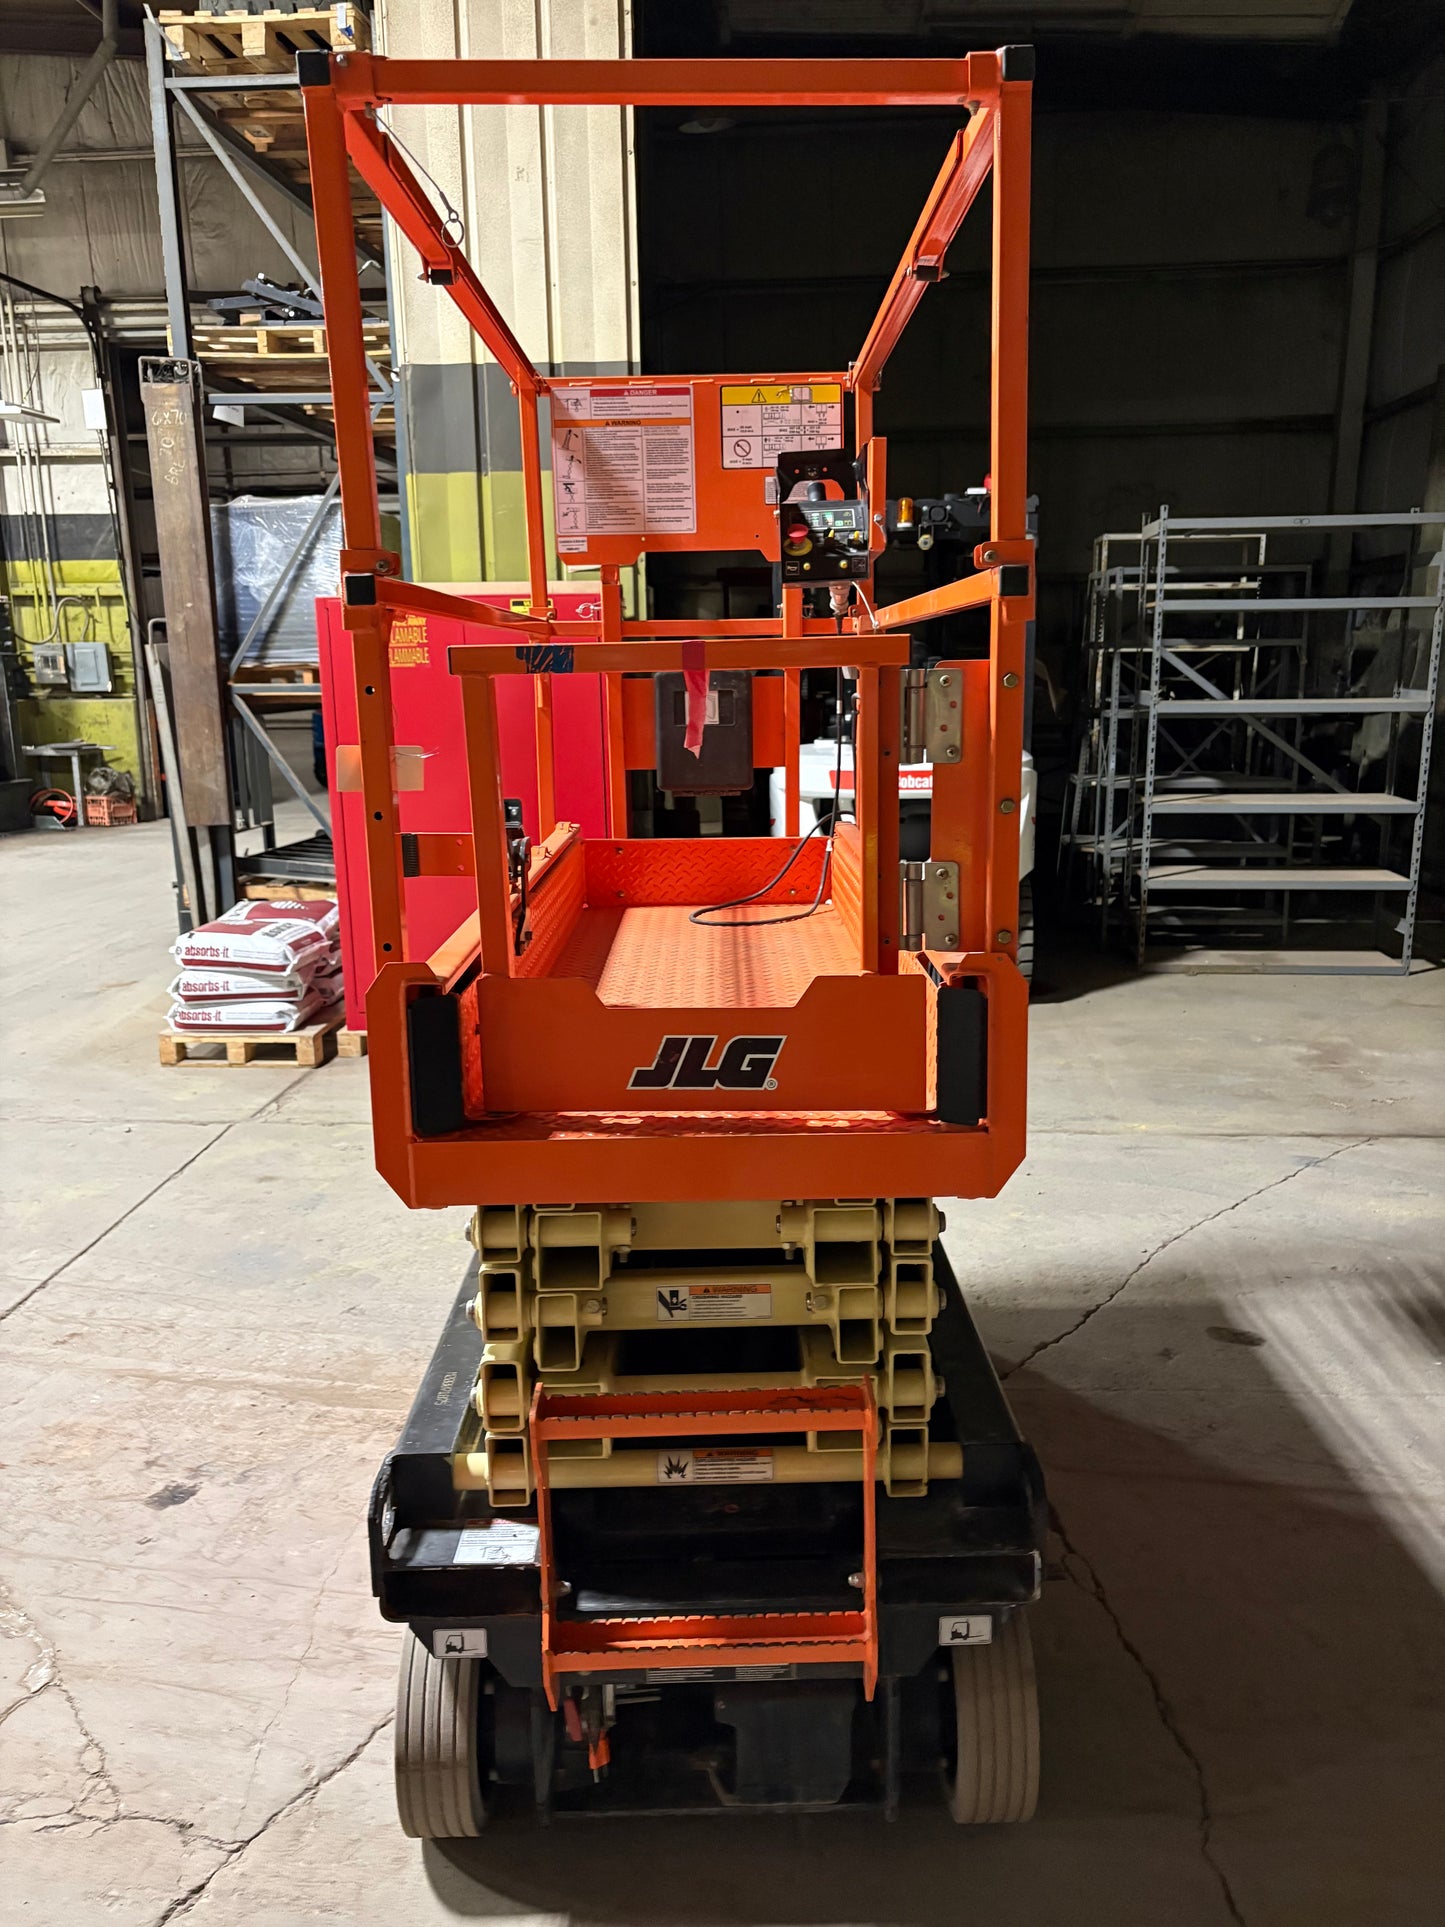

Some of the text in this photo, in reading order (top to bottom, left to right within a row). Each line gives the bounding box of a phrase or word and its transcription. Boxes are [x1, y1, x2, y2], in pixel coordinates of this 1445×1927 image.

[388, 647, 430, 664] LAMMABLE
[184, 945, 229, 959] absorbs-it
[182, 981, 230, 993] absorbs-it
[627, 1035, 787, 1090] JLG
[713, 1285, 757, 1293] WARNING
